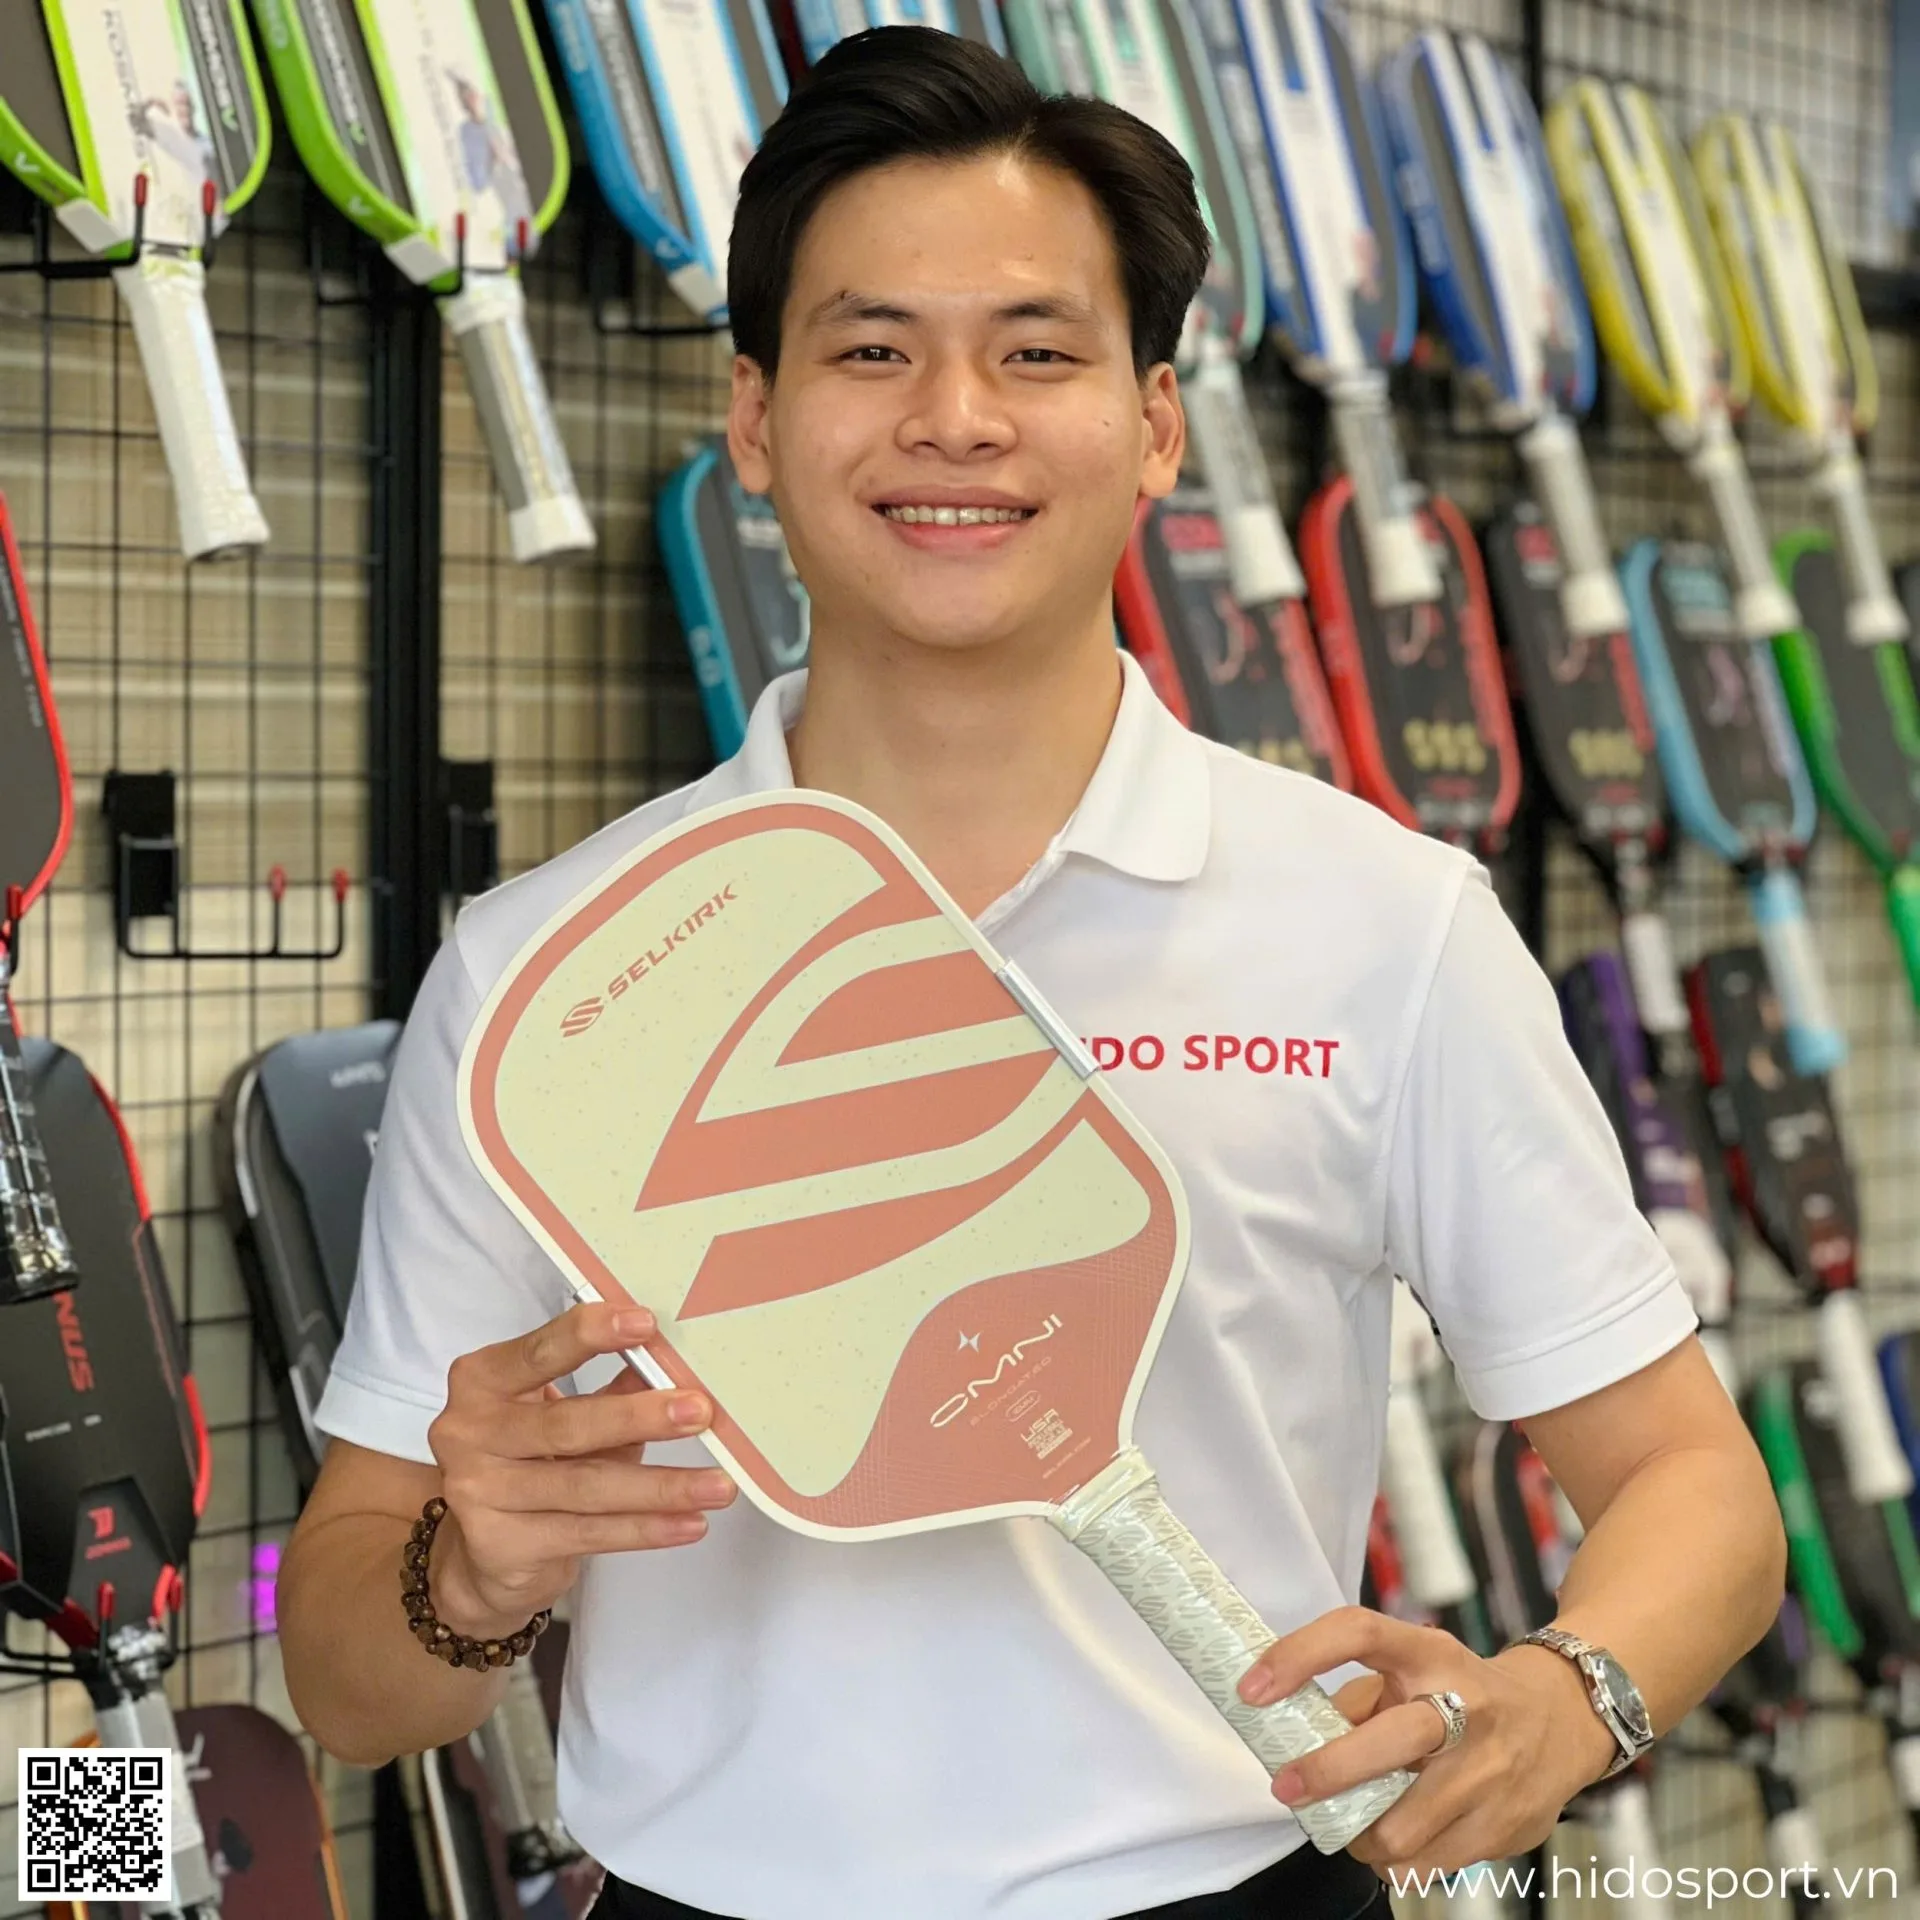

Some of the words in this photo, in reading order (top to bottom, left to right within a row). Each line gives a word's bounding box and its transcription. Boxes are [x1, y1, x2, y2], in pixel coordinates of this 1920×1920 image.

[608, 884, 738, 1000] SELKIRK
[1080, 1035, 1164, 1071] DO
[1184, 1034, 1339, 1078] SPORT
[930, 1314, 1063, 1427] OMNI
[1020, 1408, 1059, 1442] USA
